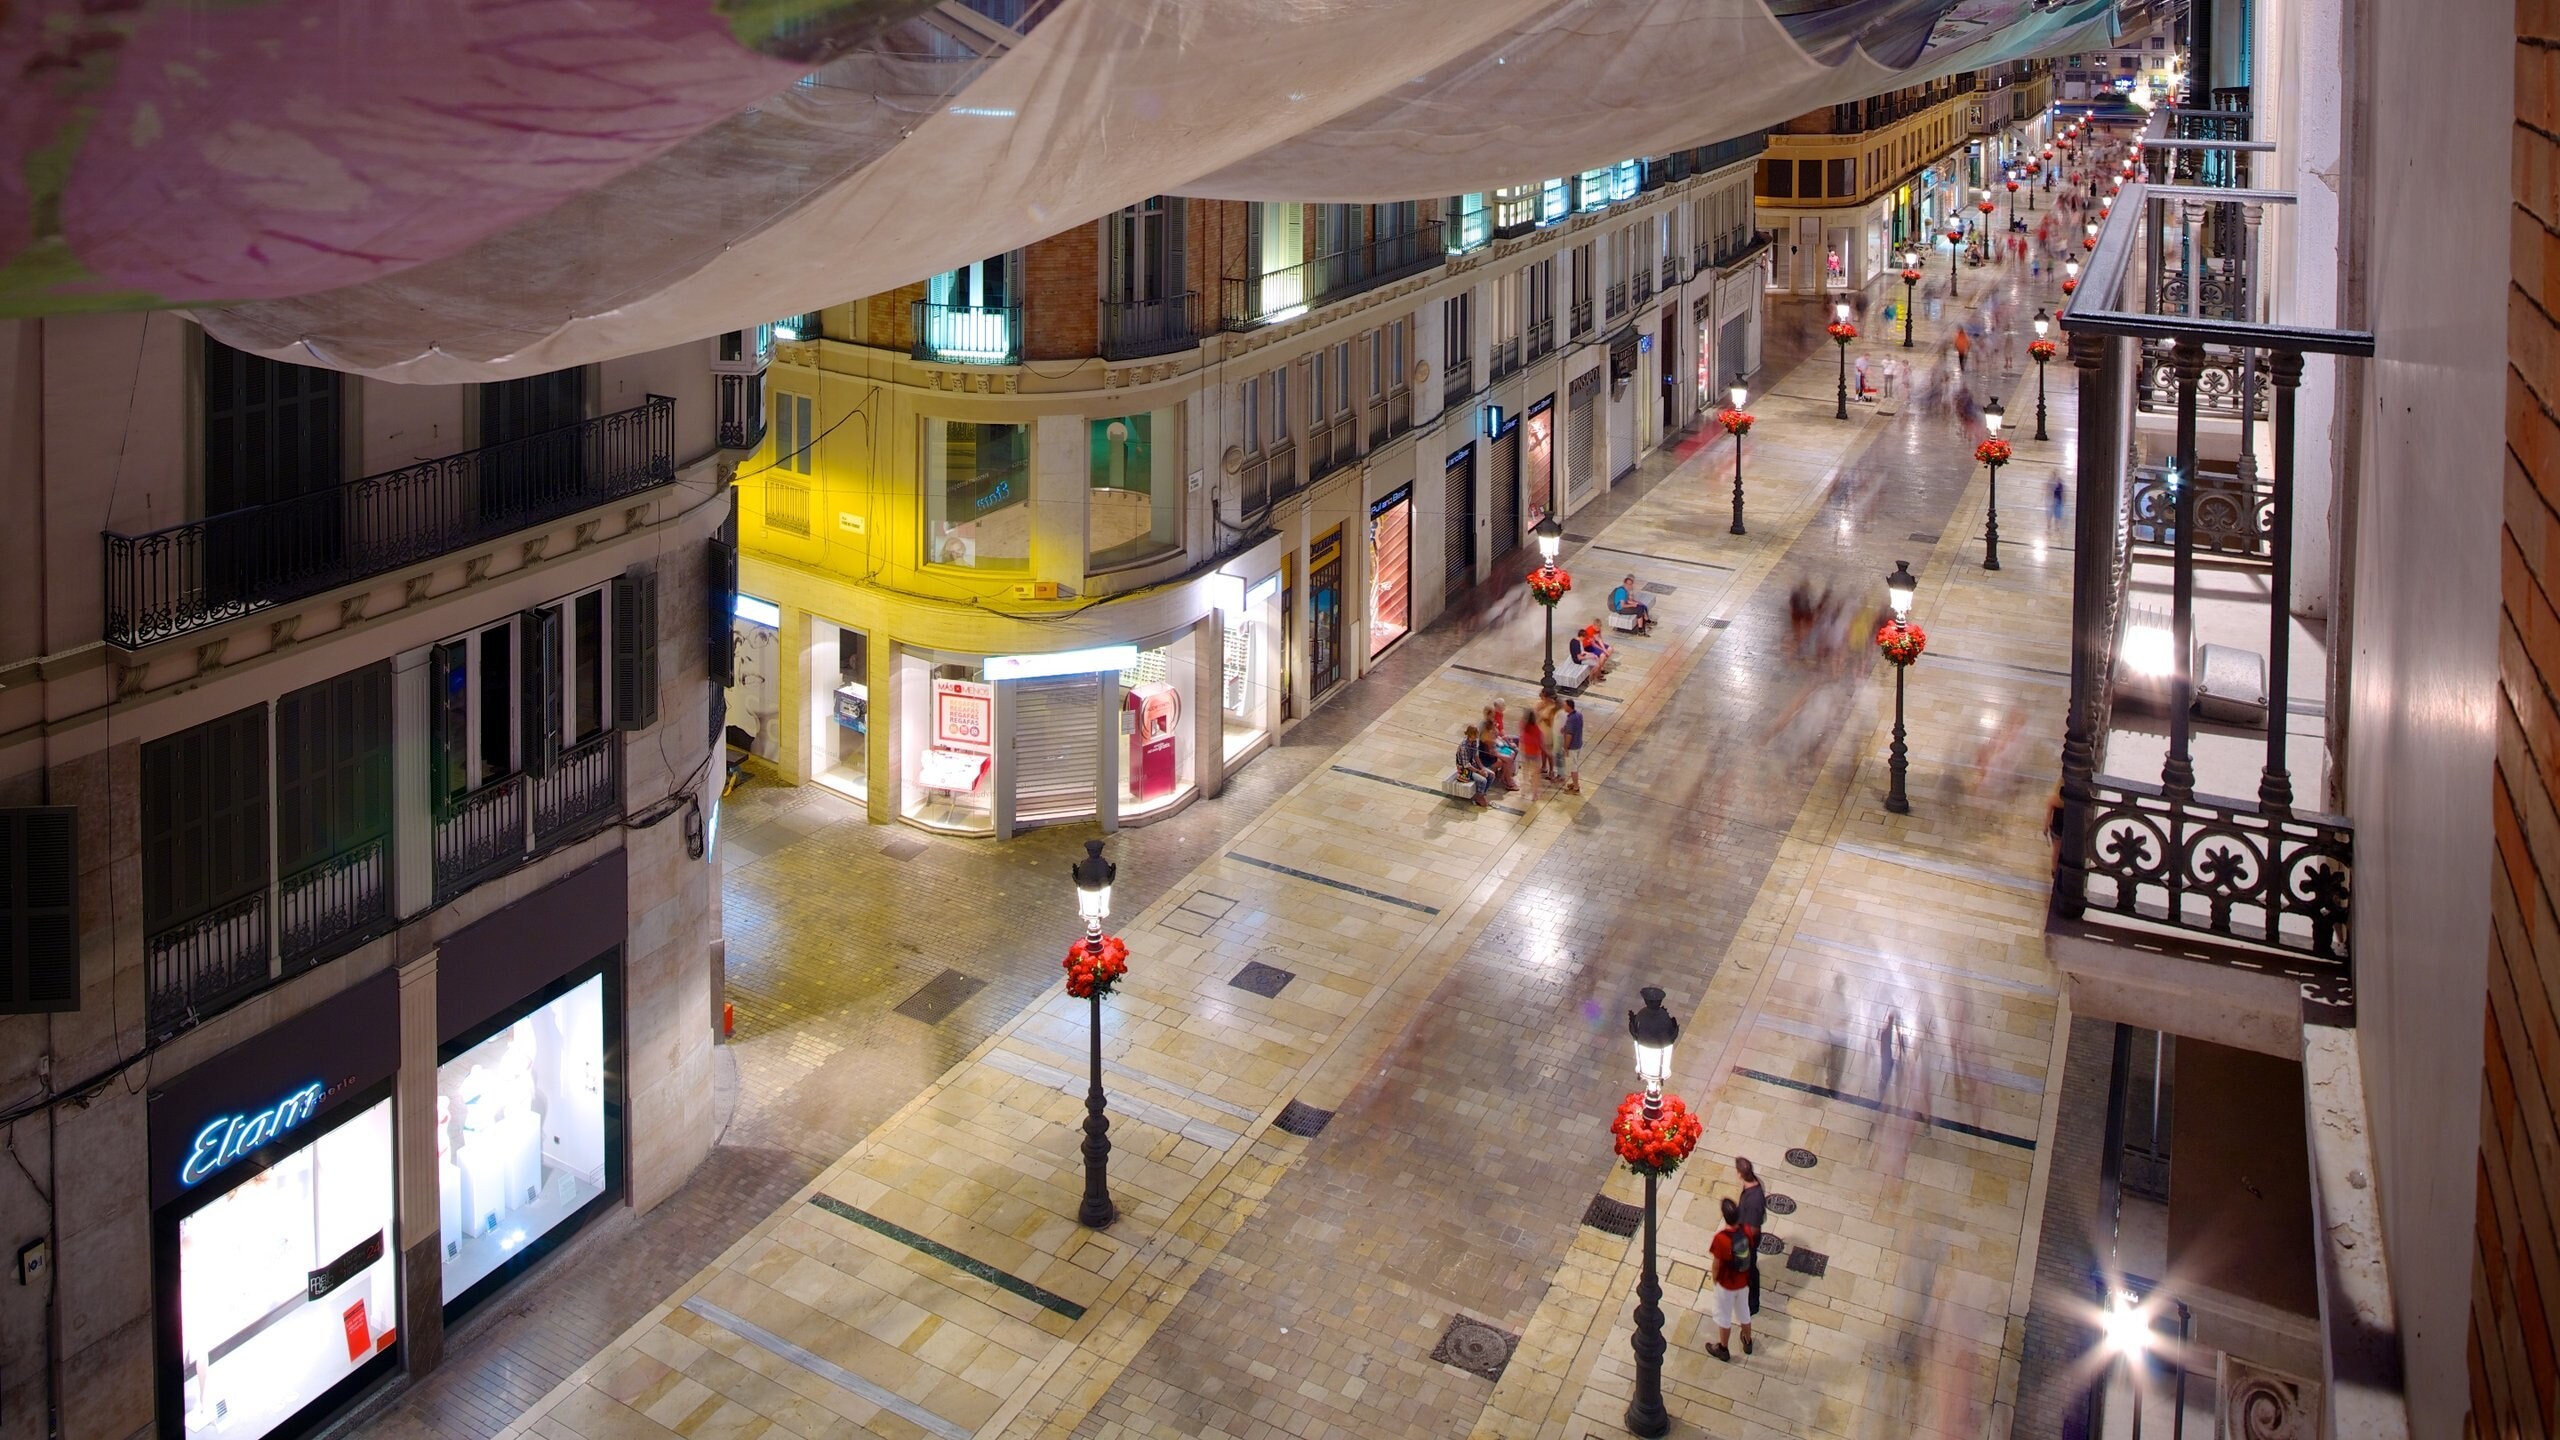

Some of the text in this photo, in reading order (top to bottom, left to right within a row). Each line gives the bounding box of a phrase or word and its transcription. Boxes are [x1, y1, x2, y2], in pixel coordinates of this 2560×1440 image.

[949, 711, 979, 720] REGAFAS
[949, 717, 979, 725] REGAFAS
[183, 1083, 322, 1183] Etam
